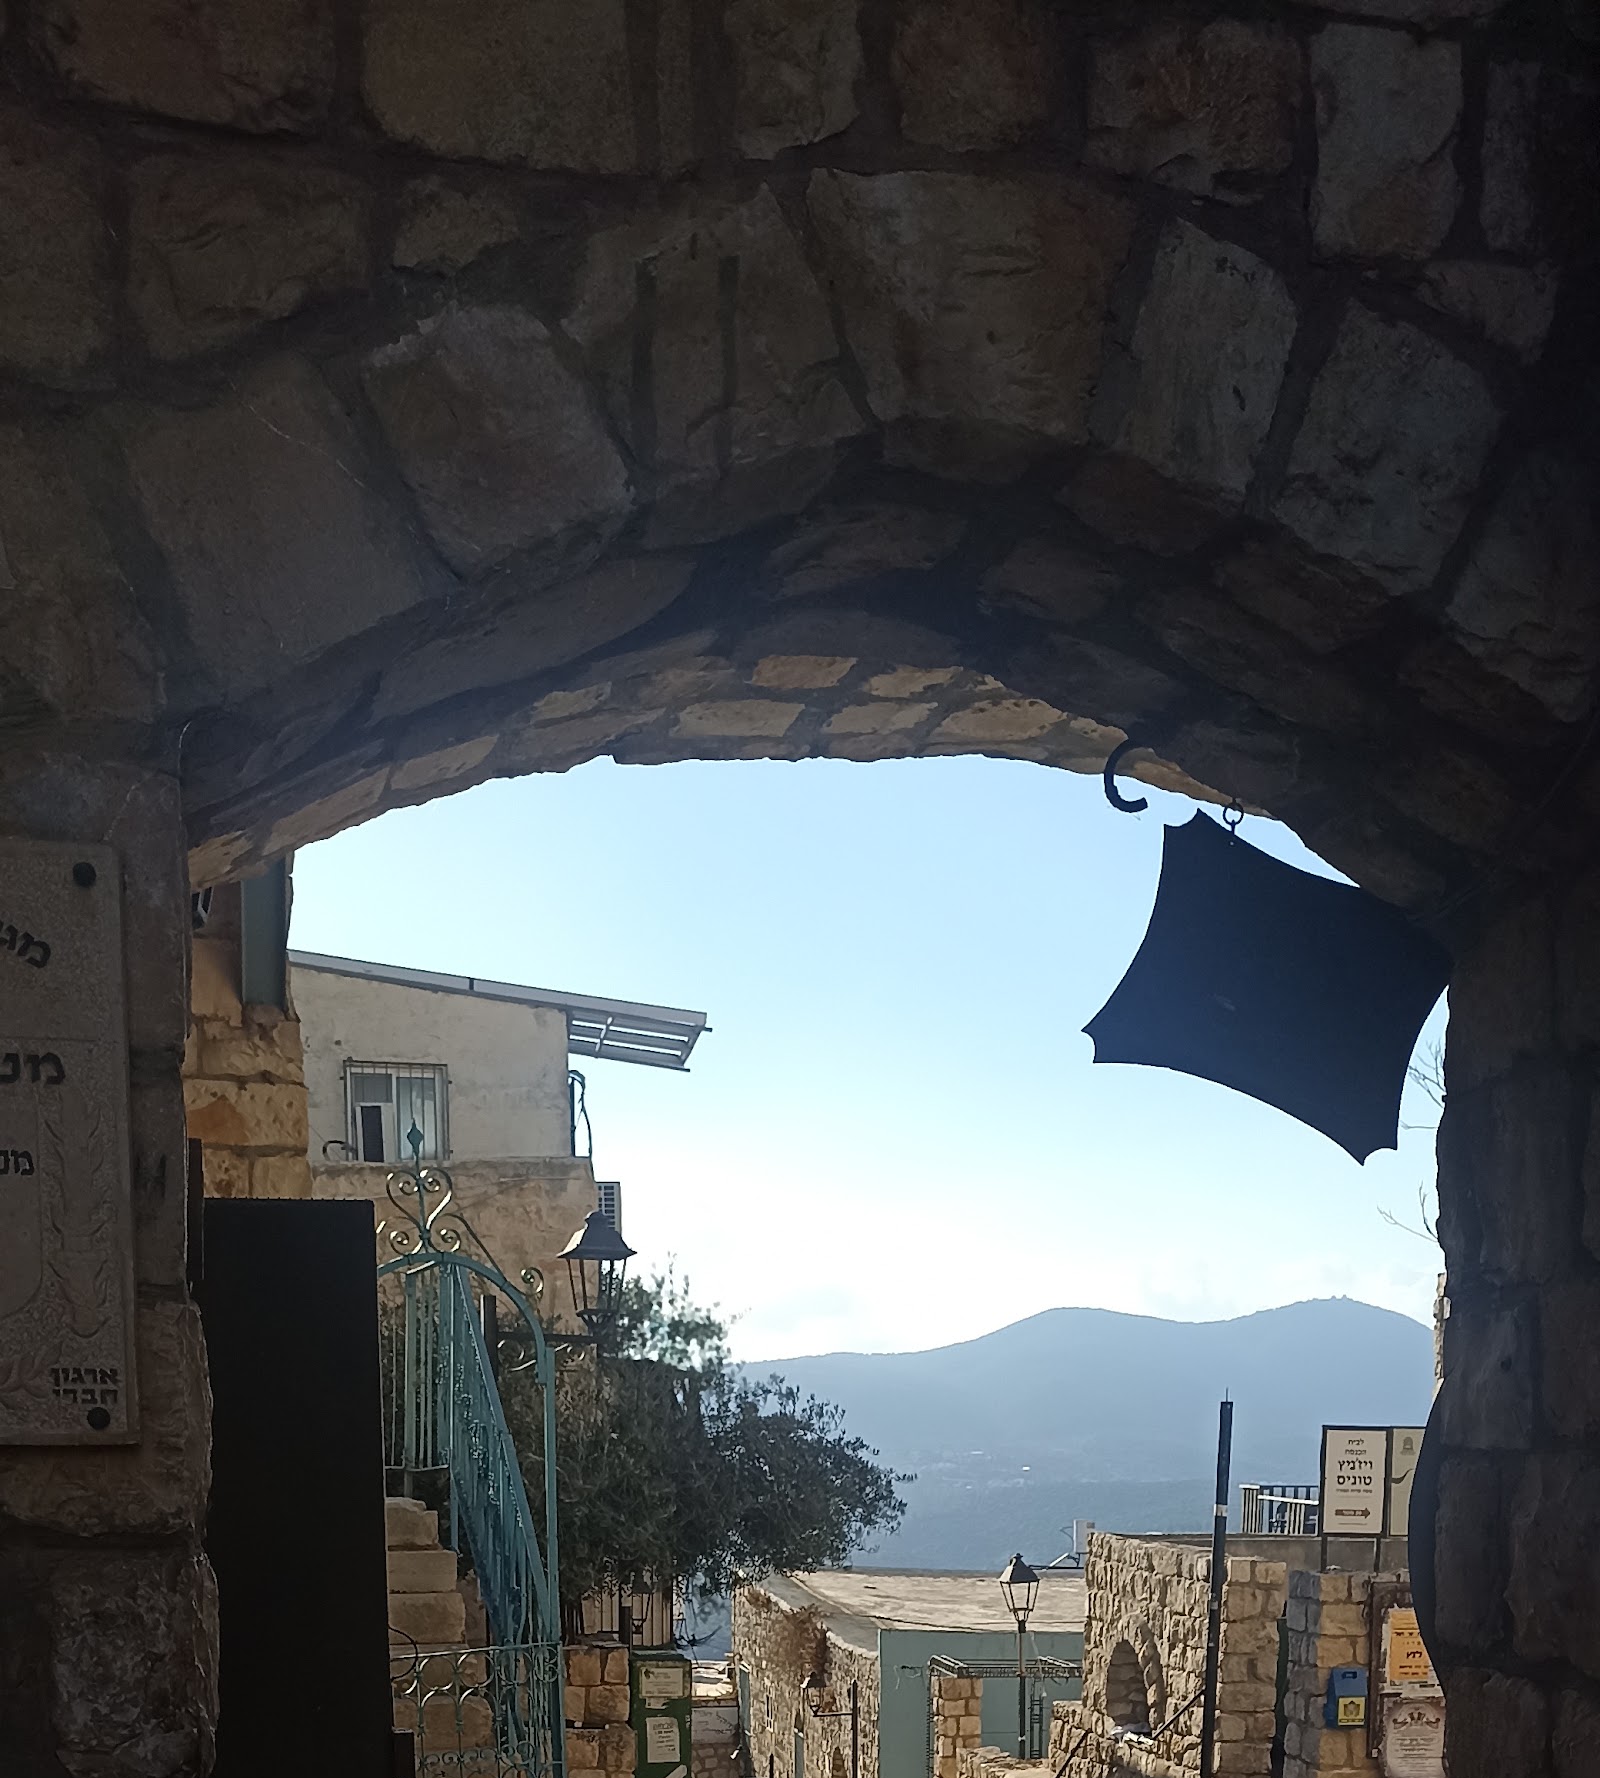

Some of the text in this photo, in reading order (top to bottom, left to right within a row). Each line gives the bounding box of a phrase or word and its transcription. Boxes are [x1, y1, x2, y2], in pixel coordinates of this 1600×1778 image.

[51, 1367, 121, 1387] ארגון
[52, 1388, 118, 1405] חברי
[1337, 1475, 1372, 1485] טוניס
